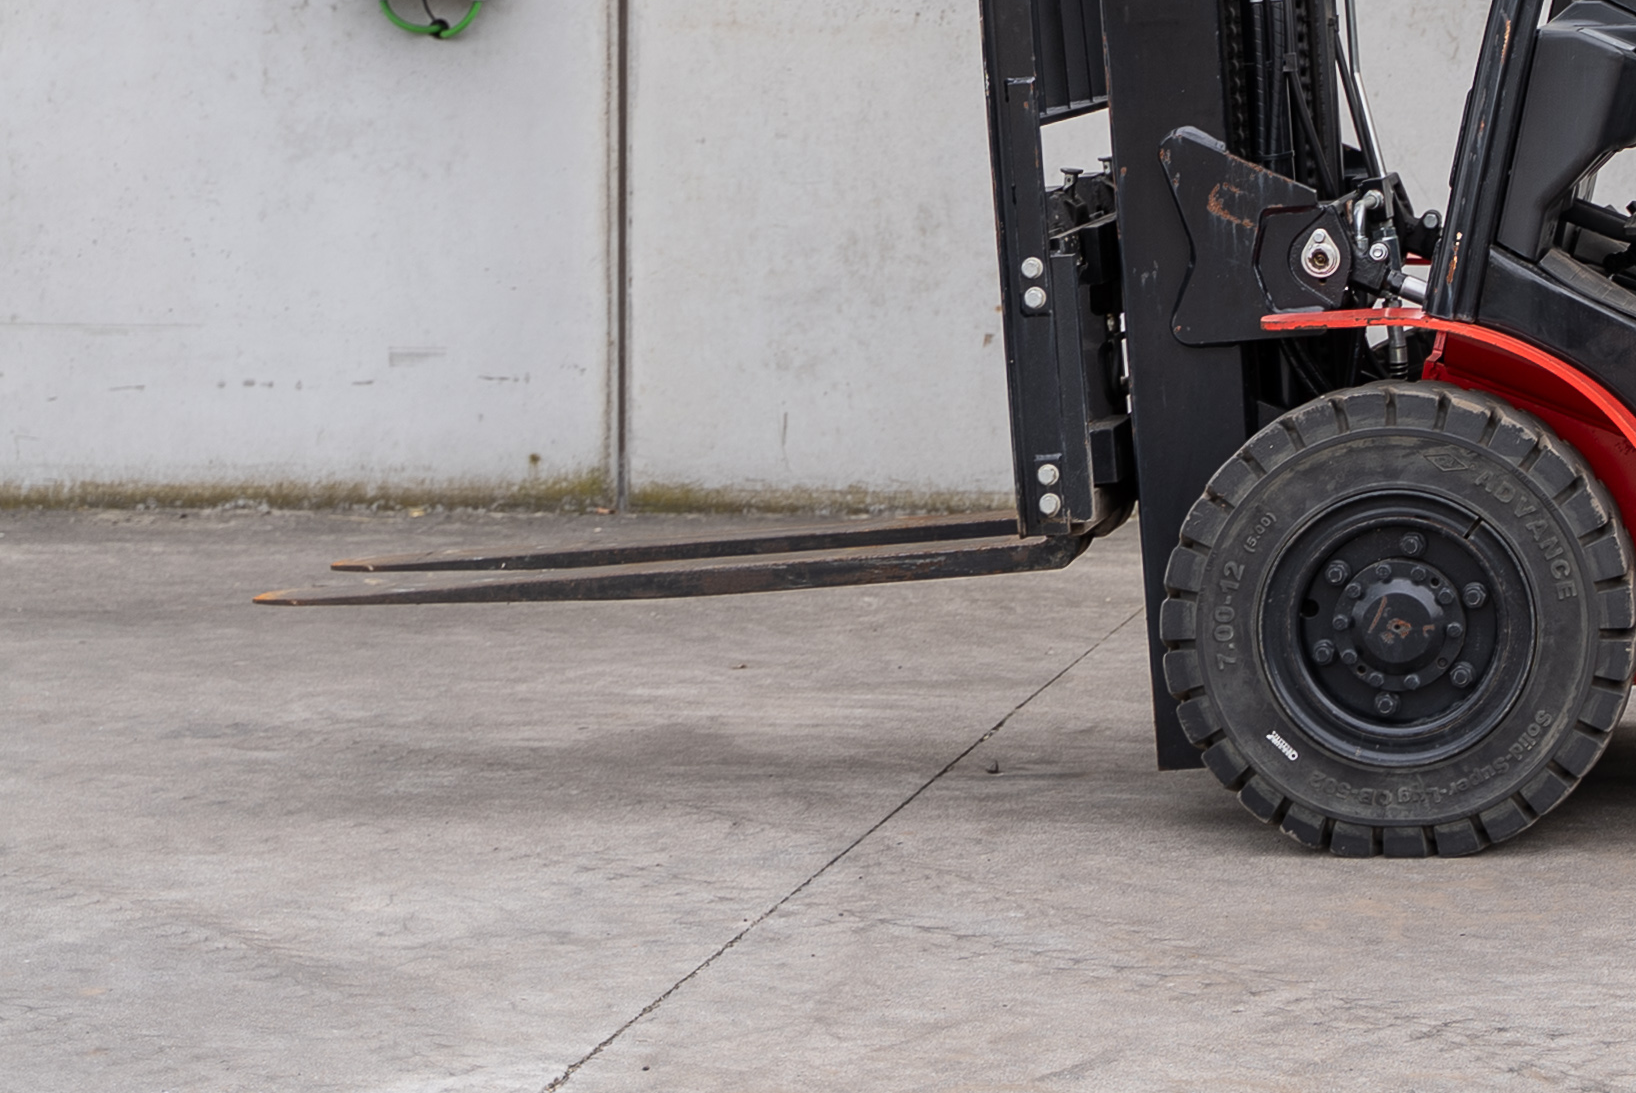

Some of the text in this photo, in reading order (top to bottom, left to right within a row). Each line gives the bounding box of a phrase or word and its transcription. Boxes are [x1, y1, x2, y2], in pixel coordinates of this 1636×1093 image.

[1217, 510, 1278, 671] 7.00-12 (5.00)
[1473, 465, 1578, 601] ADVANCE
